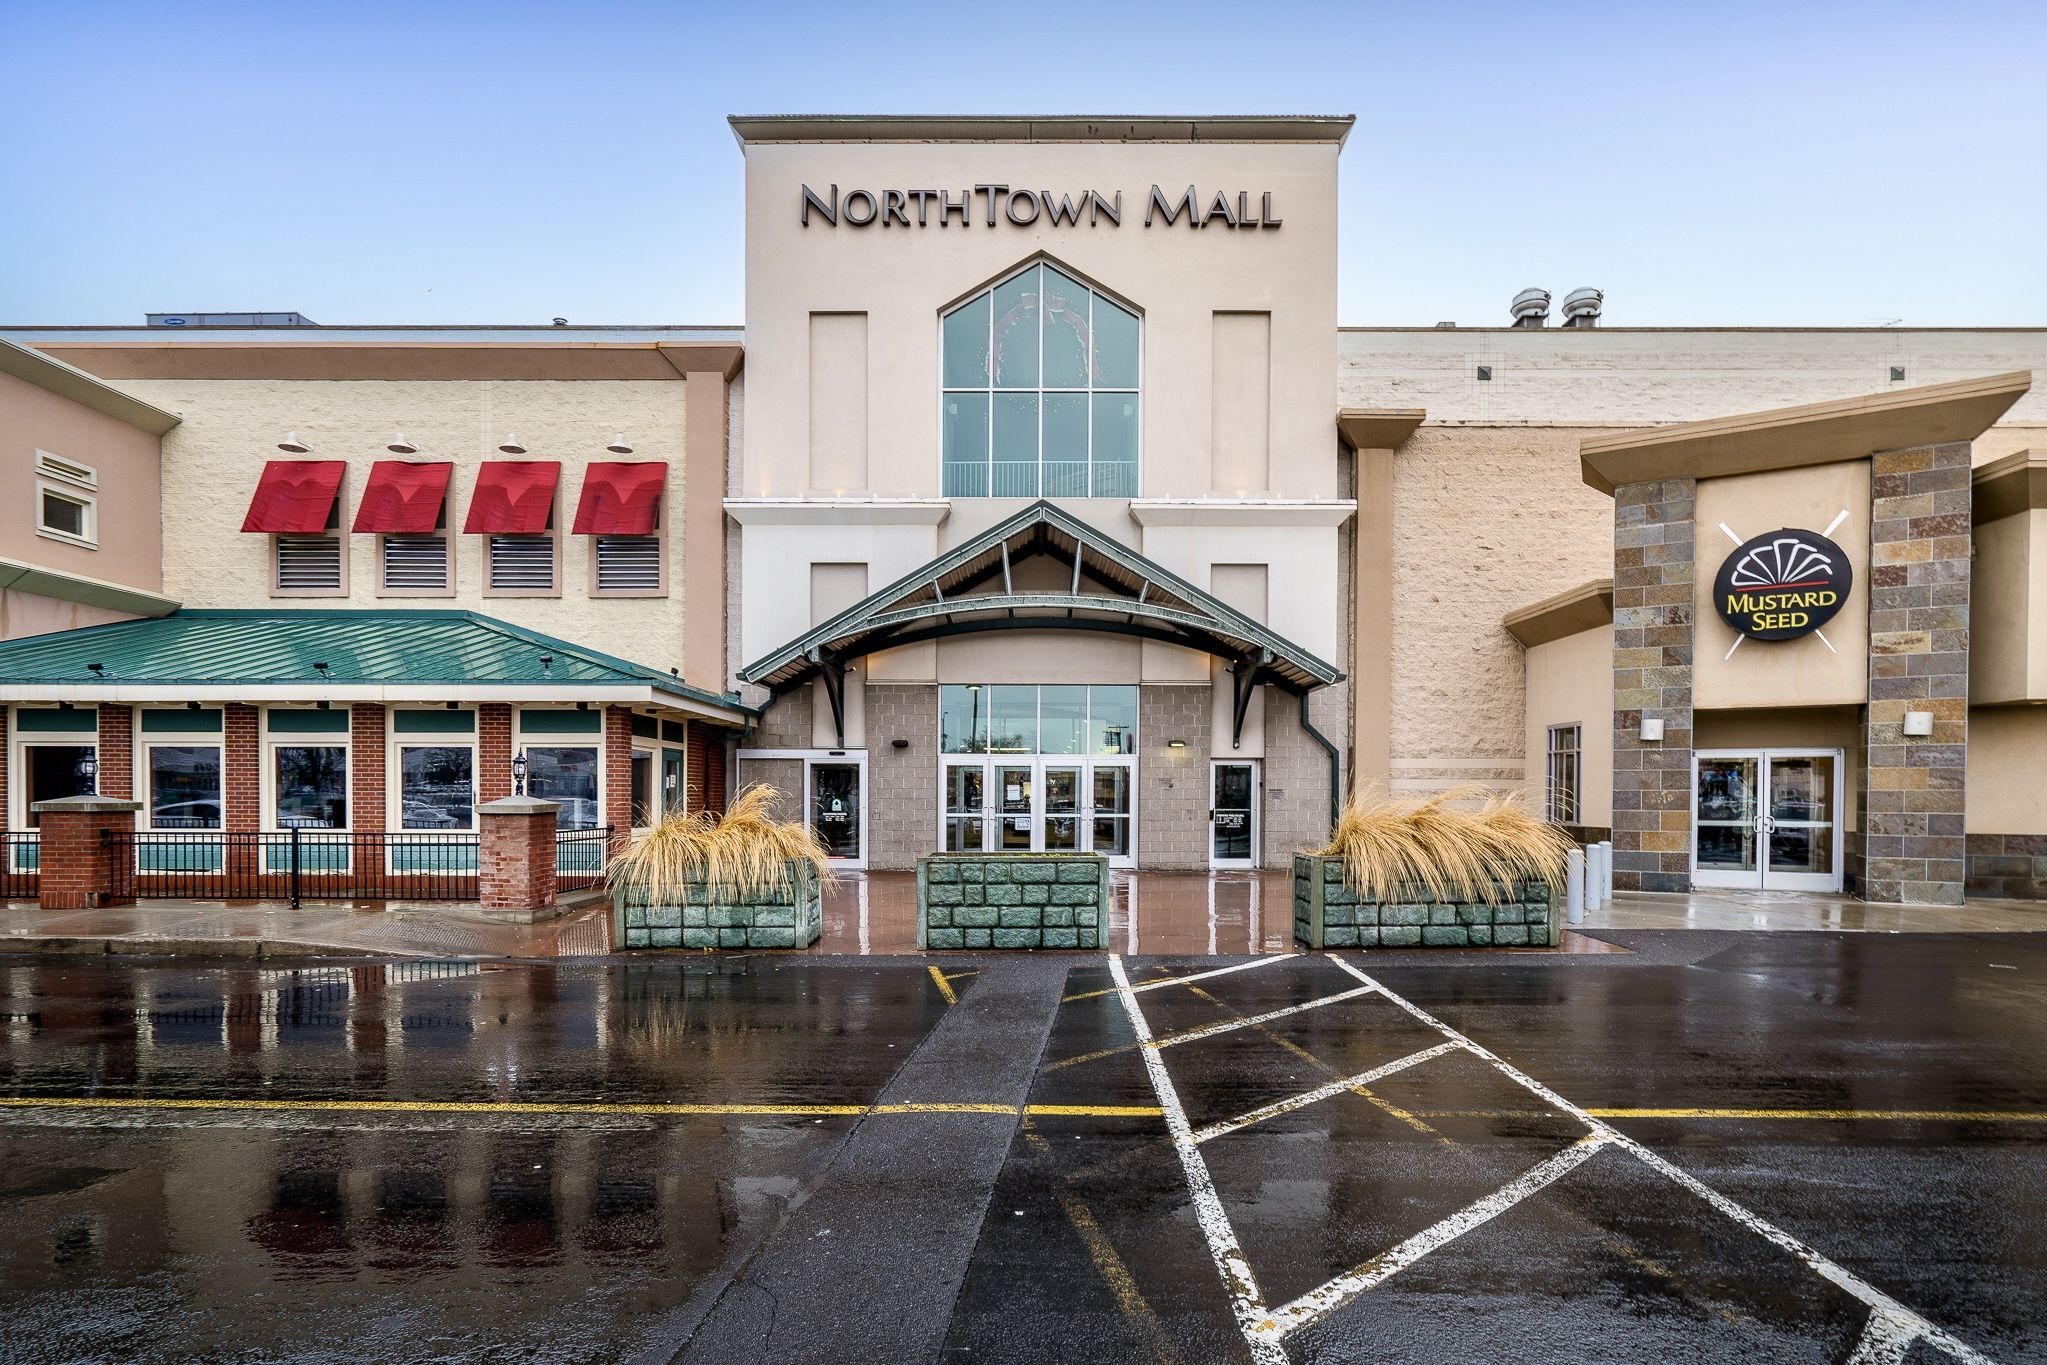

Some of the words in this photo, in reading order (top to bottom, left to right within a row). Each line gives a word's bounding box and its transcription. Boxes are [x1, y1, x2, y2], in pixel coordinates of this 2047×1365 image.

[801, 183, 1122, 228] NORTHTOWN
[1144, 184, 1283, 229] MALL
[1727, 591, 1837, 615] MUSTARD
[1752, 612, 1809, 631] SEED
